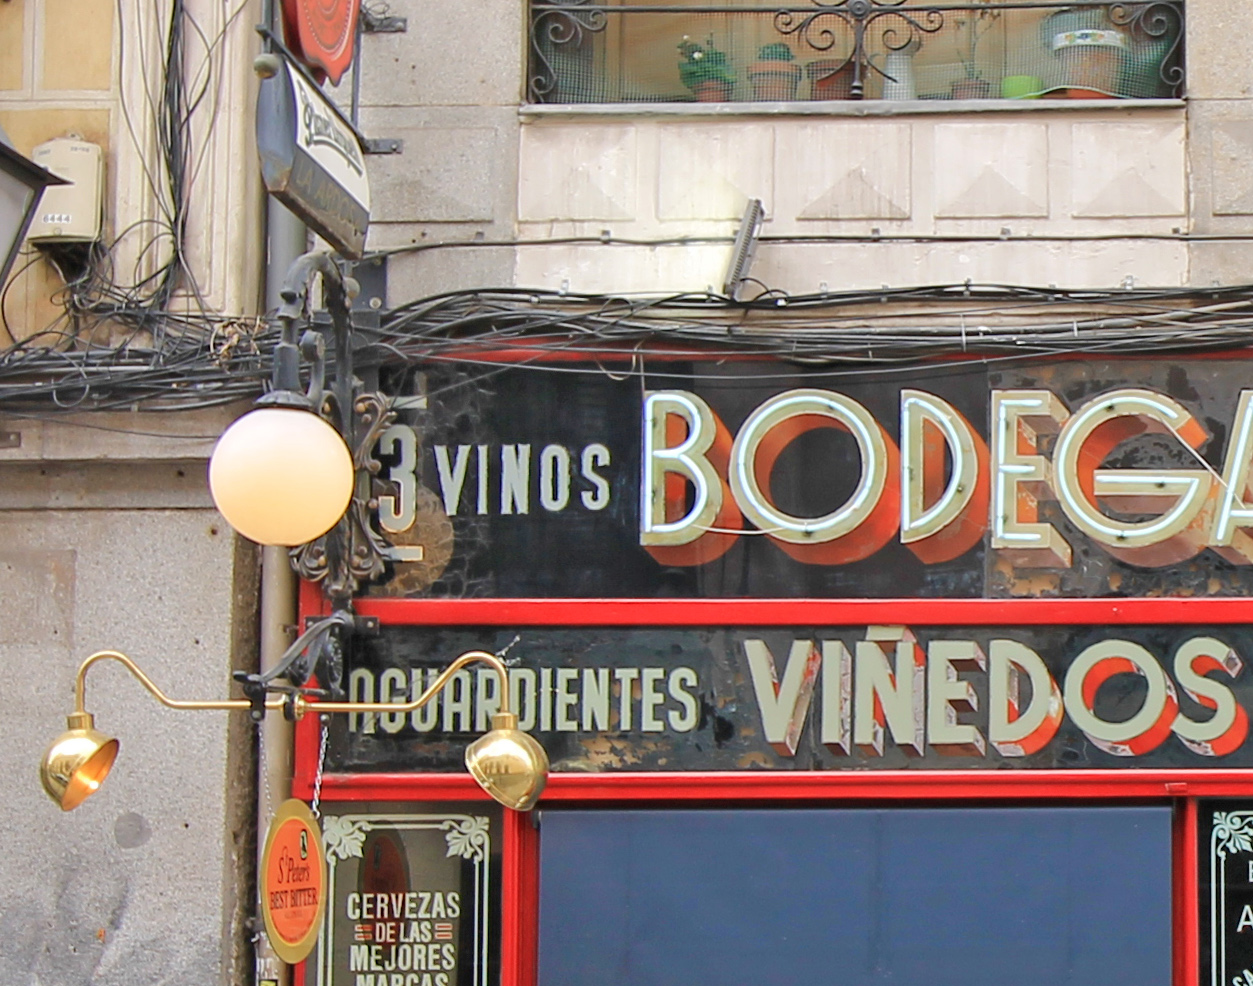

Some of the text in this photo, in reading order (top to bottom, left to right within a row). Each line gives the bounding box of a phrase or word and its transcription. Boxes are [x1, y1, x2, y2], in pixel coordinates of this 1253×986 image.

[434, 443, 611, 517] VINOS
[348, 667, 698, 734] AGUARDIENTES
[744, 625, 1243, 750] VIÑEDOS
[270, 887, 318, 911] BEST BITTER
[346, 891, 461, 920] CERVEZAS
[375, 921, 432, 943] DE LAS
[349, 944, 456, 972] MEJORES
